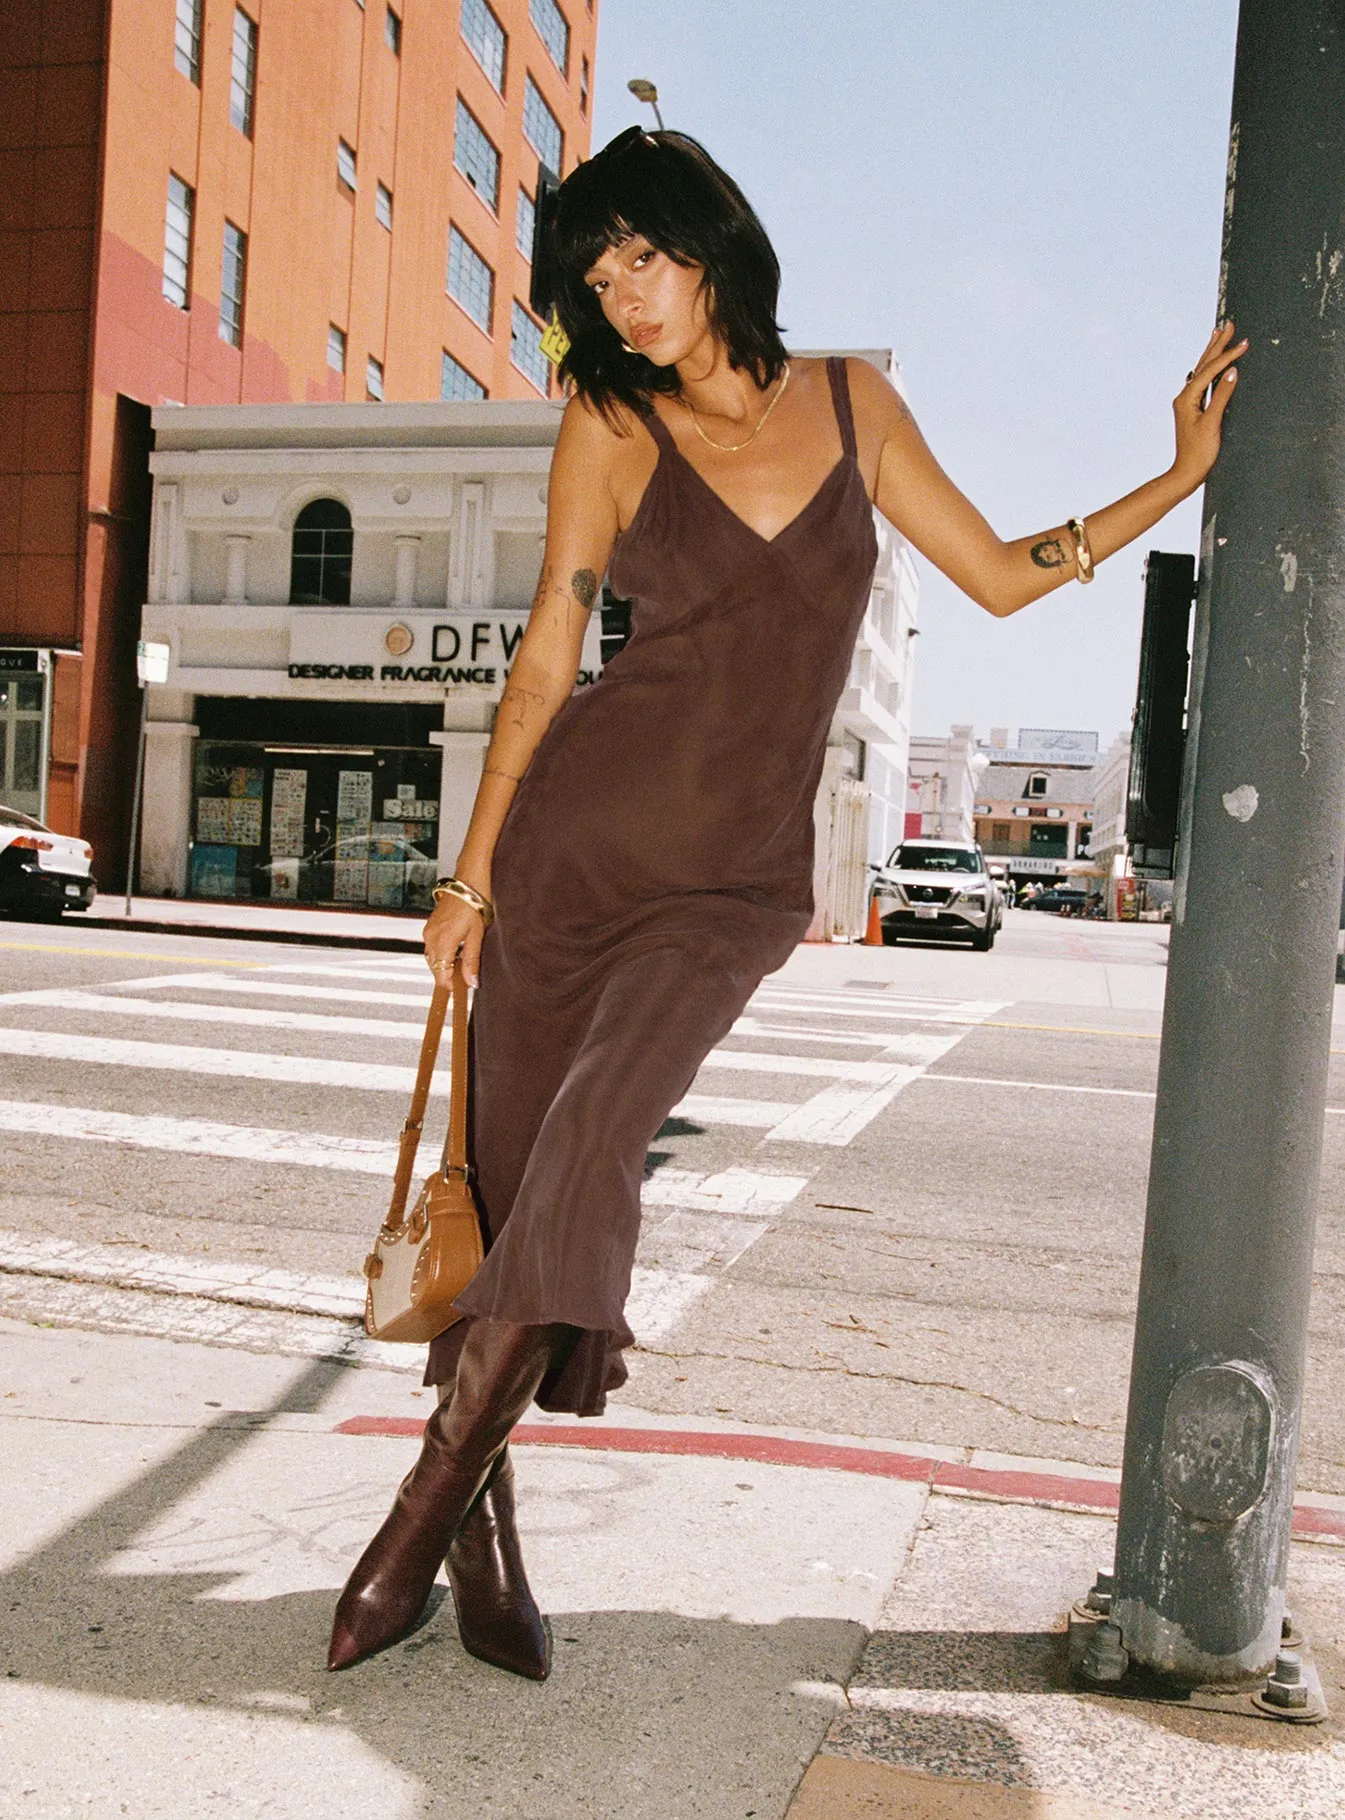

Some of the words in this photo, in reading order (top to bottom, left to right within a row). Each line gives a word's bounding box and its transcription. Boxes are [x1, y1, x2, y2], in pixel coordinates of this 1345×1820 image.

[288, 664, 374, 680] DESIGNER
[380, 665, 496, 683] FRAGRANCE
[386, 800, 437, 818] Sale
